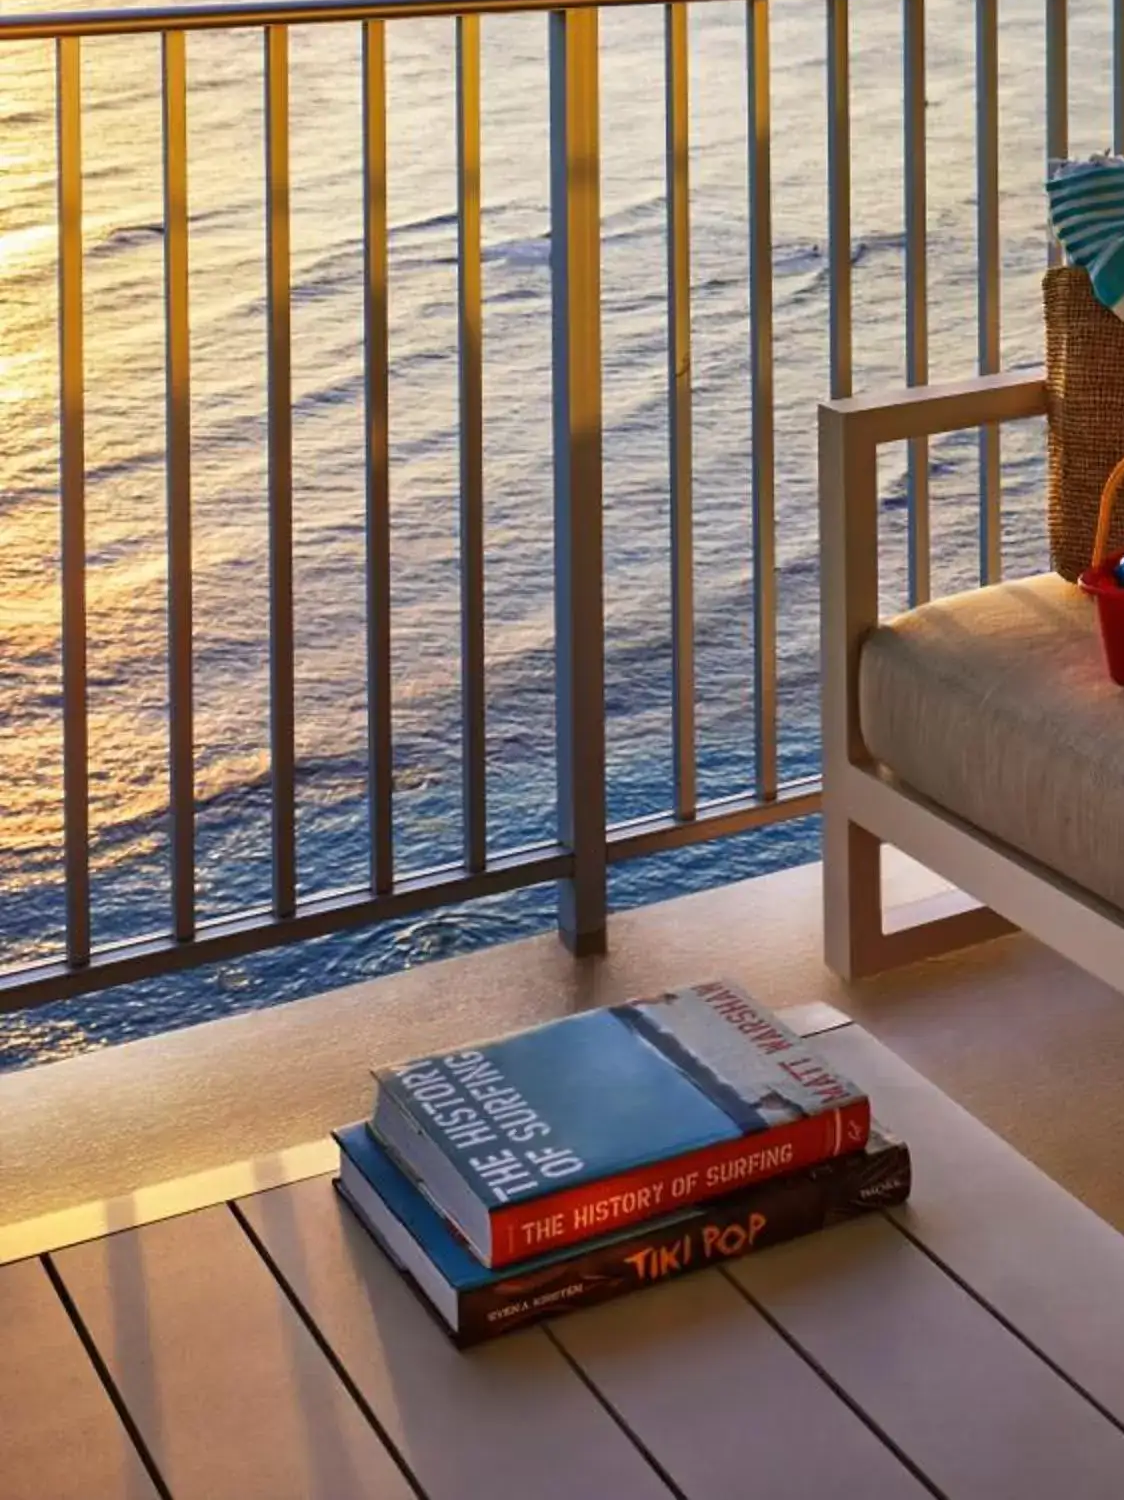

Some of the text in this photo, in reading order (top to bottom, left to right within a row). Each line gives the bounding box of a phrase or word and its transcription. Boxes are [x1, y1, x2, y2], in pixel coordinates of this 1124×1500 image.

[690, 981, 851, 1104] MATT WARSHAW
[392, 1060, 538, 1203] THE HISTORY
[444, 1050, 585, 1178] OF SURFING
[521, 1143, 793, 1245] THE HISTORY OF SURFING
[624, 1212, 767, 1280] TIKI POP
